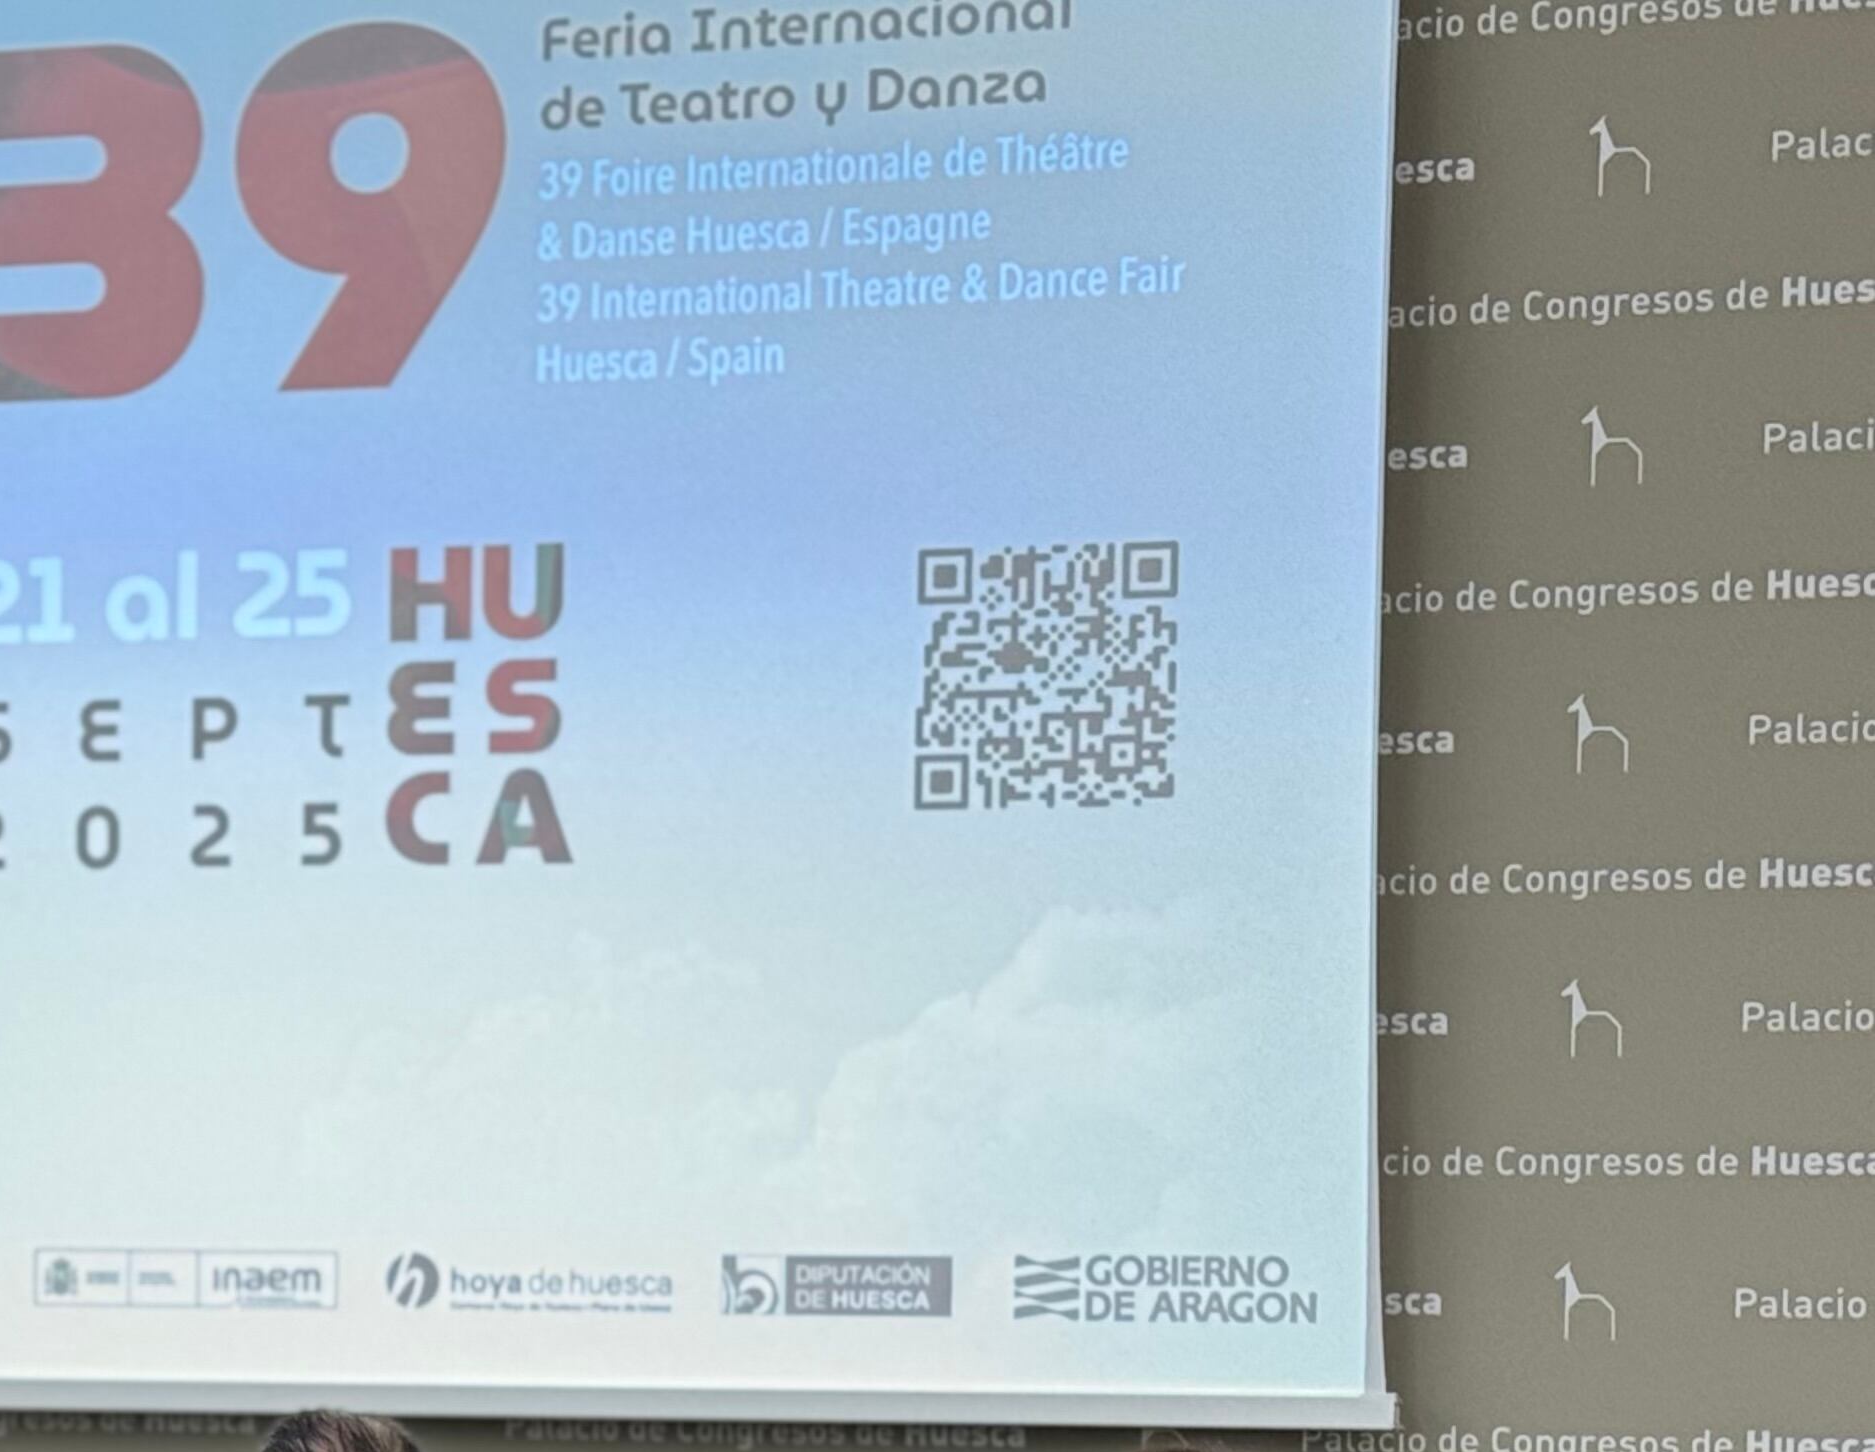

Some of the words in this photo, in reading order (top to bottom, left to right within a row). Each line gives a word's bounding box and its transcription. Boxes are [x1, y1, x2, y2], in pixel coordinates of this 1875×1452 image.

[543, 12, 671, 62] Feria
[691, 0, 1070, 52] Internacional
[1478, 5, 1518, 35] de
[1532, 0, 1722, 35] Congresos
[541, 86, 605, 131] de
[619, 82, 795, 125] Teatro
[816, 82, 846, 126] y
[868, 68, 1046, 112] Danza
[539, 160, 582, 200] 39
[594, 158, 676, 197] Foire
[688, 139, 932, 192] Internationale
[944, 136, 987, 178] de
[996, 132, 1129, 174] Théâtre
[1396, 158, 1475, 183] esca
[538, 222, 562, 262] &
[573, 222, 676, 259] Danse
[688, 216, 809, 253] Huesca
[820, 207, 834, 248] /
[844, 208, 991, 256] Espagne
[537, 283, 581, 323] 39
[591, 269, 812, 320] International
[821, 268, 951, 308] Theatre
[962, 263, 987, 303] &
[1000, 262, 1108, 301] Dance
[1120, 254, 1186, 295] Fair
[1470, 294, 1510, 324] de
[1524, 289, 1714, 325] Congresos
[1727, 279, 1768, 310] de
[537, 344, 657, 382] Huesca
[666, 336, 680, 378] /
[688, 336, 784, 386] Spain
[1764, 418, 1874, 453] Palaci
[106, 551, 198, 644] al
[233, 550, 351, 638] 25
[390, 542, 564, 642] HU
[1457, 581, 1496, 611] de
[1510, 580, 1698, 615] Congresos
[1712, 572, 1753, 602] de
[1768, 569, 1875, 599] Huesc
[385, 768, 573, 865] CA
[1450, 865, 1490, 894] de
[1504, 864, 1692, 900] Congresos
[1705, 860, 1746, 889] de
[1760, 858, 1872, 888] Huesc
[1742, 1000, 1874, 1032] Palacio
[1444, 1146, 1483, 1175] de
[1497, 1146, 1684, 1183] Congresos
[1697, 1146, 1738, 1175] de
[450, 1268, 522, 1299] hoya
[528, 1269, 563, 1295] de
[570, 1270, 673, 1296] huesca
[796, 1262, 929, 1288] DIPUTACIÓN
[1086, 1254, 1289, 1287] GOBIERNO
[796, 1290, 827, 1311] DE
[831, 1290, 929, 1311] HUESCA
[1085, 1291, 1135, 1322] DE
[1148, 1291, 1318, 1323] ARAGON
[1735, 1288, 1866, 1319] Palacio
